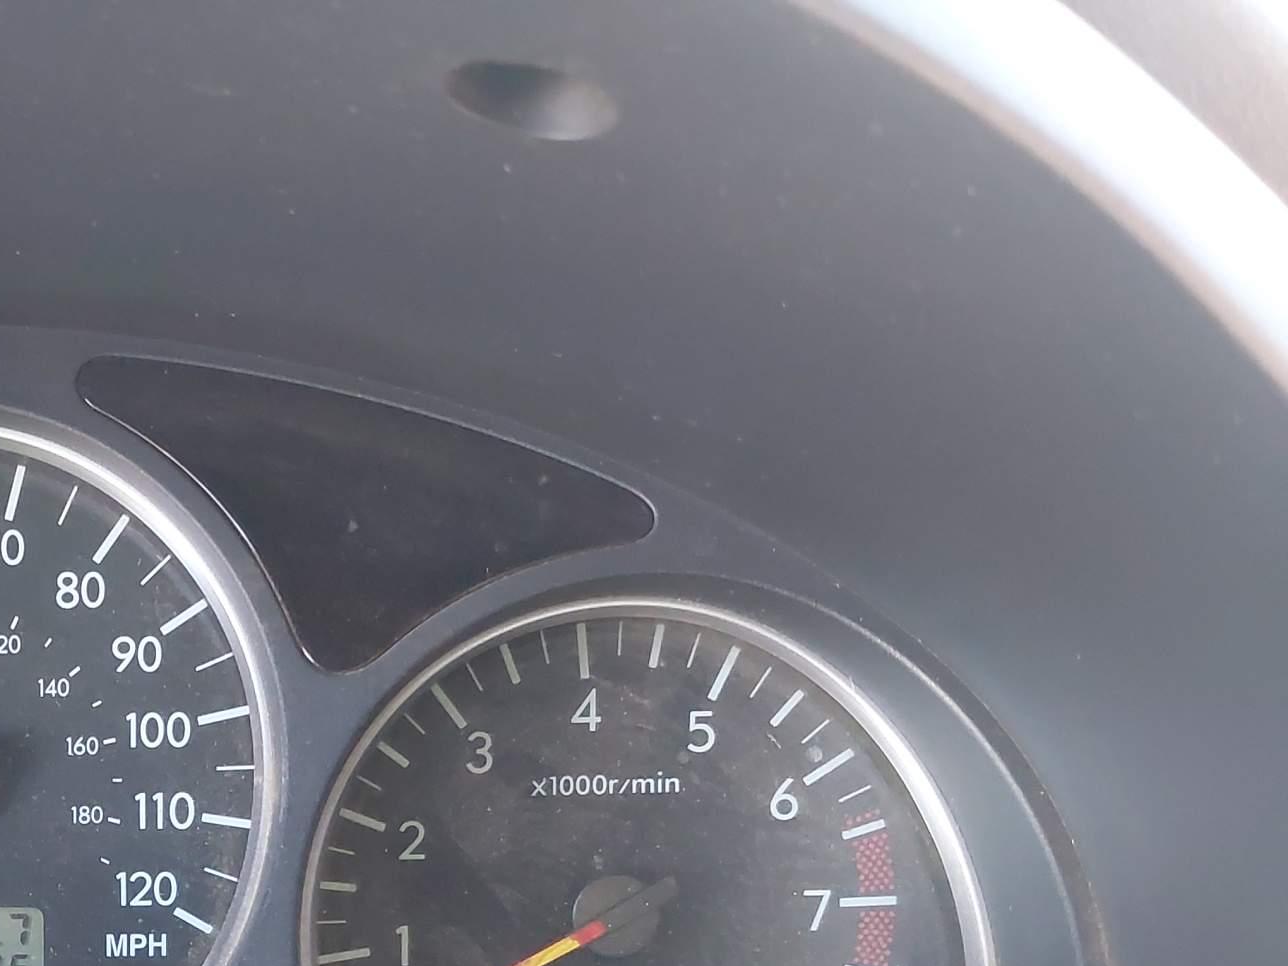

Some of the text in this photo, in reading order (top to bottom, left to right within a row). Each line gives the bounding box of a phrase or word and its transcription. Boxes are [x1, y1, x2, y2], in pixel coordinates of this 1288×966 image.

[55, 571, 106, 609] 80
[111, 636, 163, 673] 90
[36, 677, 70, 698] 140
[570, 688, 603, 732] 4
[65, 735, 100, 756] 160
[124, 712, 192, 748] 100
[687, 711, 717, 753] 5
[467, 731, 494, 775] 3
[531, 773, 681, 796] x1000r/min
[770, 778, 800, 821] 6
[71, 805, 104, 825] 180
[133, 793, 196, 830] 110
[398, 820, 427, 861] 2
[115, 872, 178, 906] 120
[802, 890, 832, 931] 7
[105, 932, 168, 958] MPH
[395, 925, 410, 966] 1
